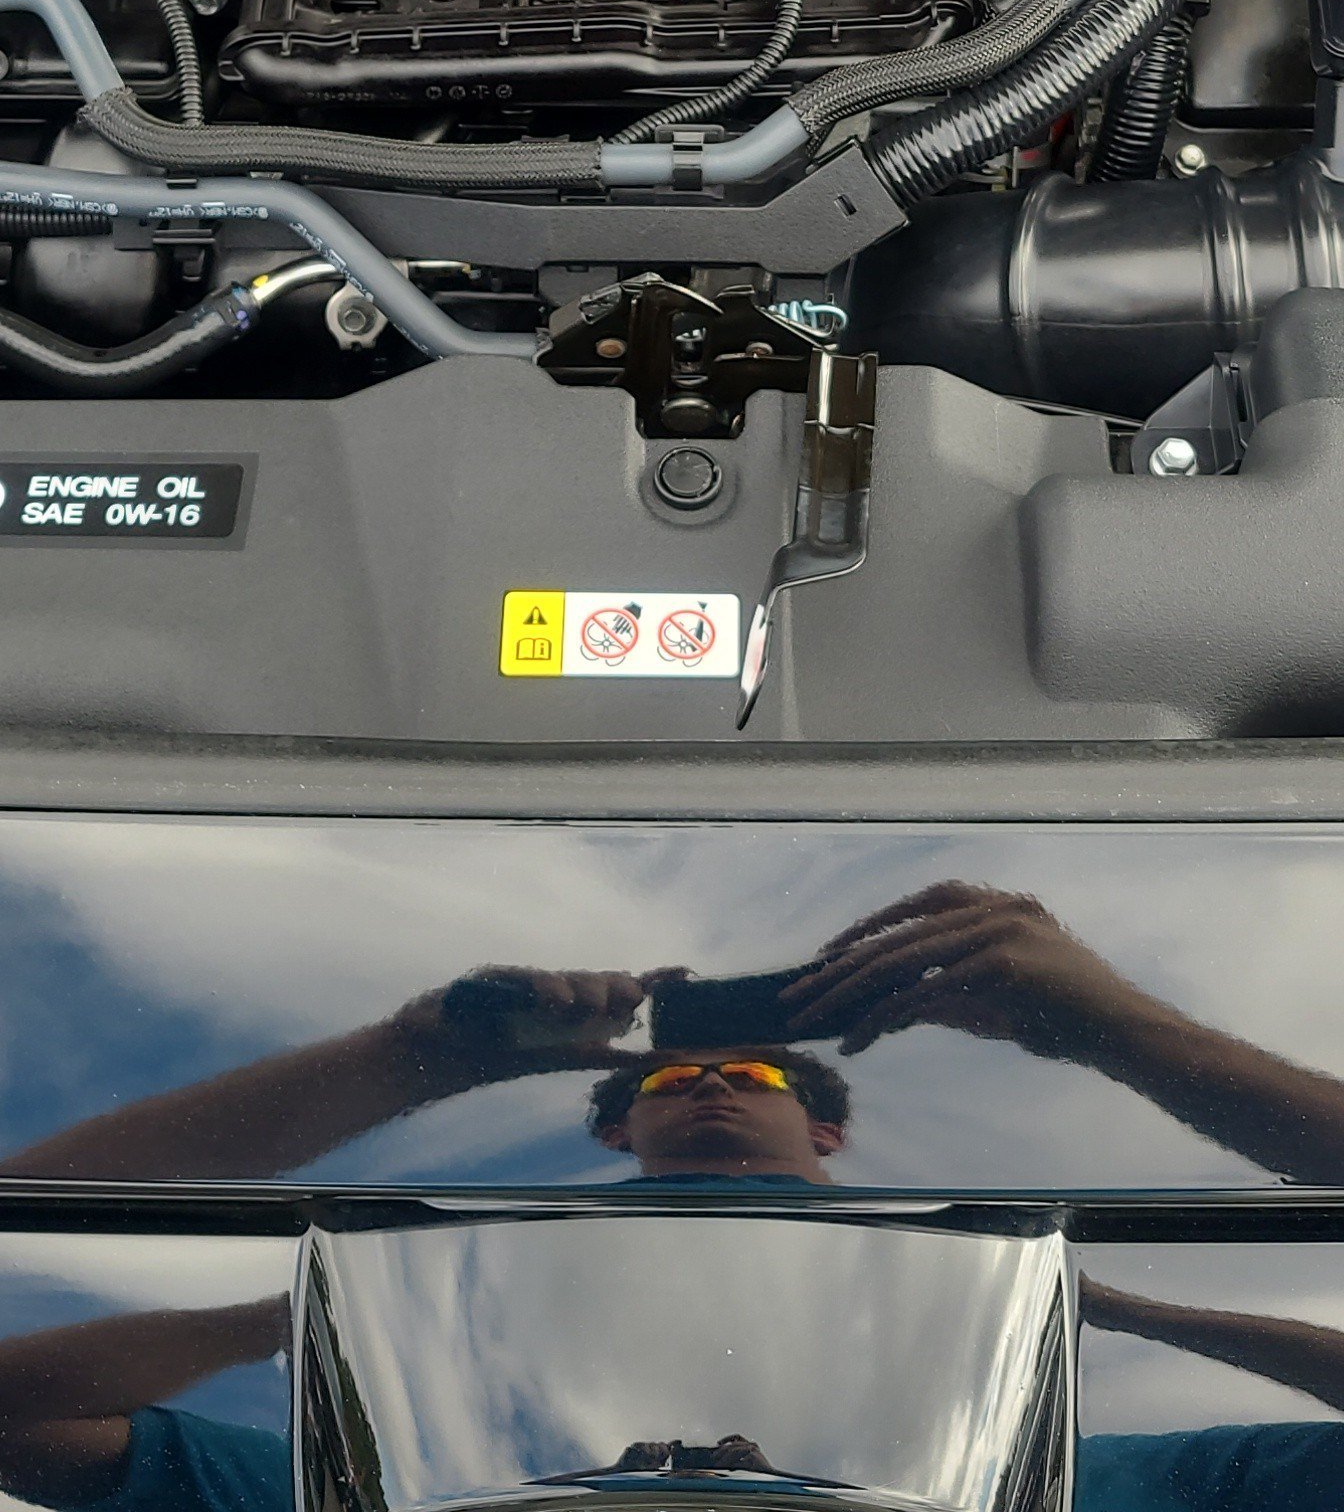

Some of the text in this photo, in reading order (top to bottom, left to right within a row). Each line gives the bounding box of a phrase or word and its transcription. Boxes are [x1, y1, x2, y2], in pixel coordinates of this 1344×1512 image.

[27, 475, 206, 499] ENGINE OIL
[21, 502, 201, 527] SAE 0W-16
